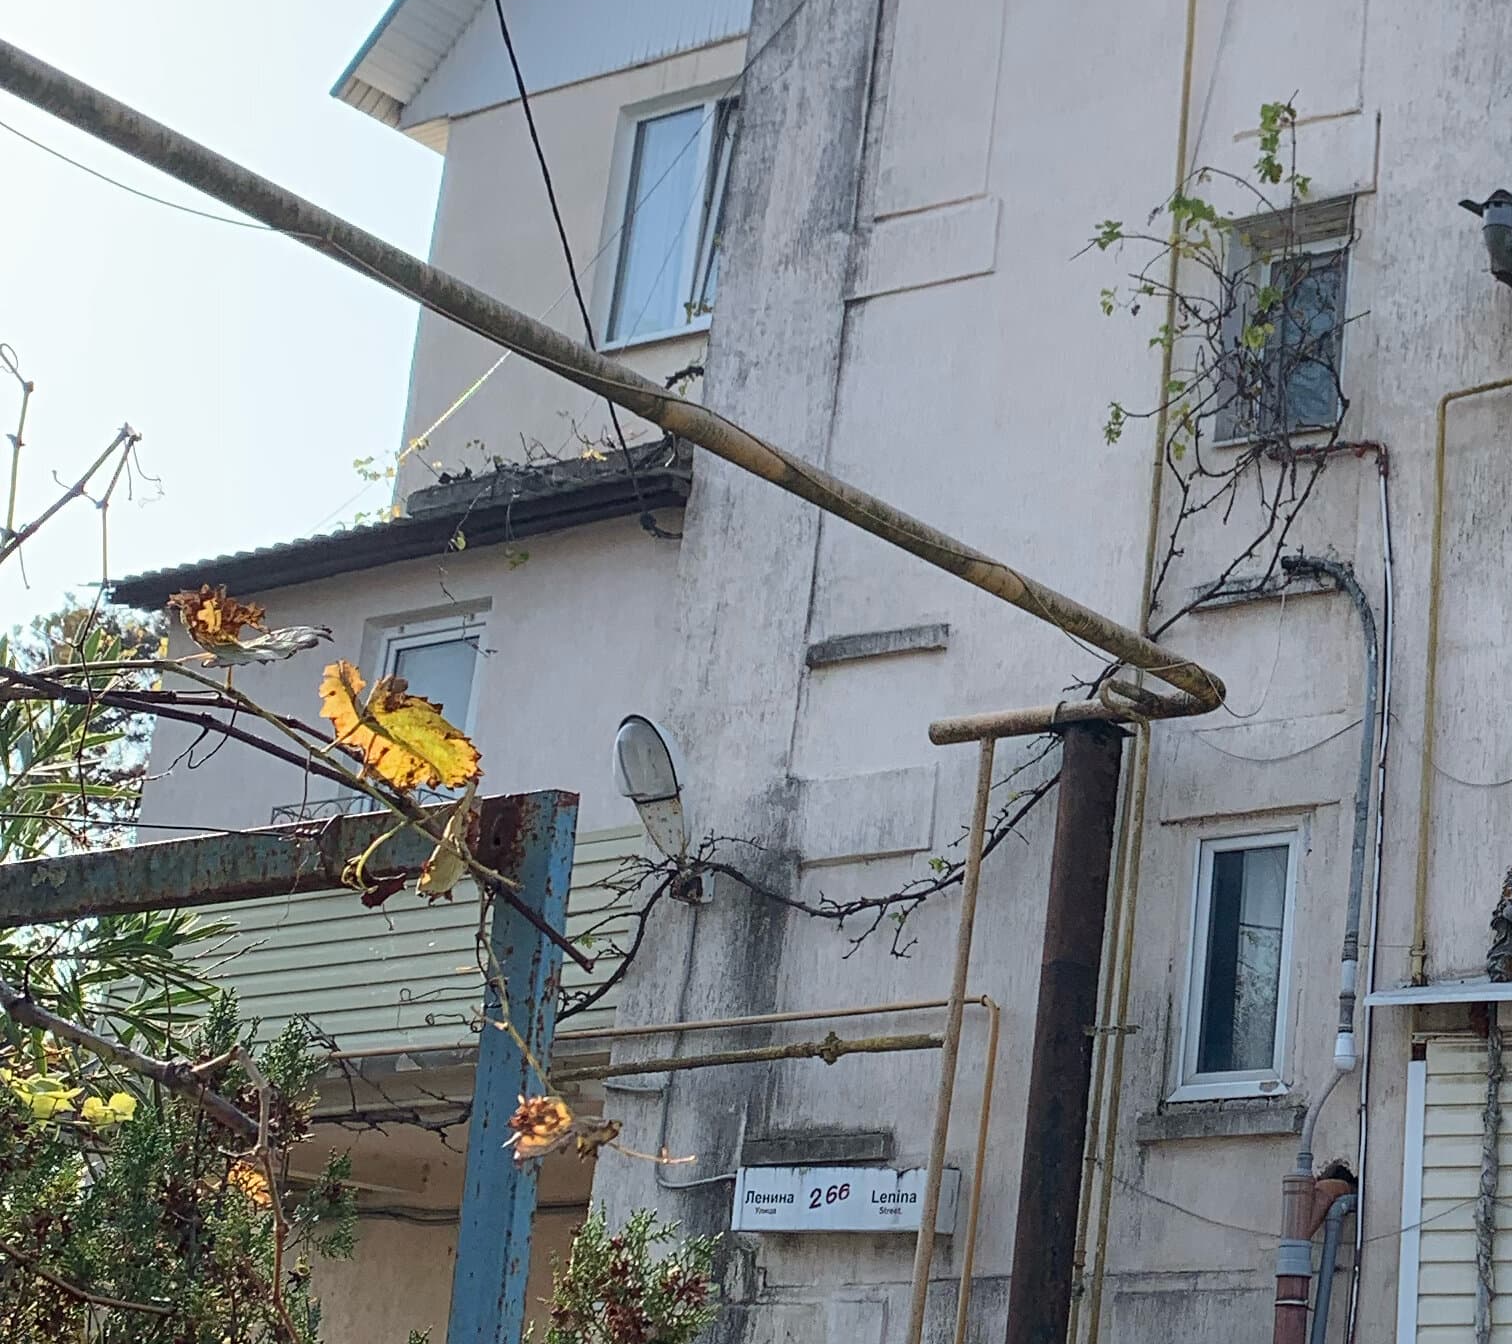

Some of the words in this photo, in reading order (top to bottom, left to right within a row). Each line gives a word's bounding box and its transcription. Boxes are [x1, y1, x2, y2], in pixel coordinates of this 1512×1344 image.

[745, 1190, 795, 1204] Ленина
[808, 1183, 850, 1209] 266
[871, 1189, 917, 1203] Lenina
